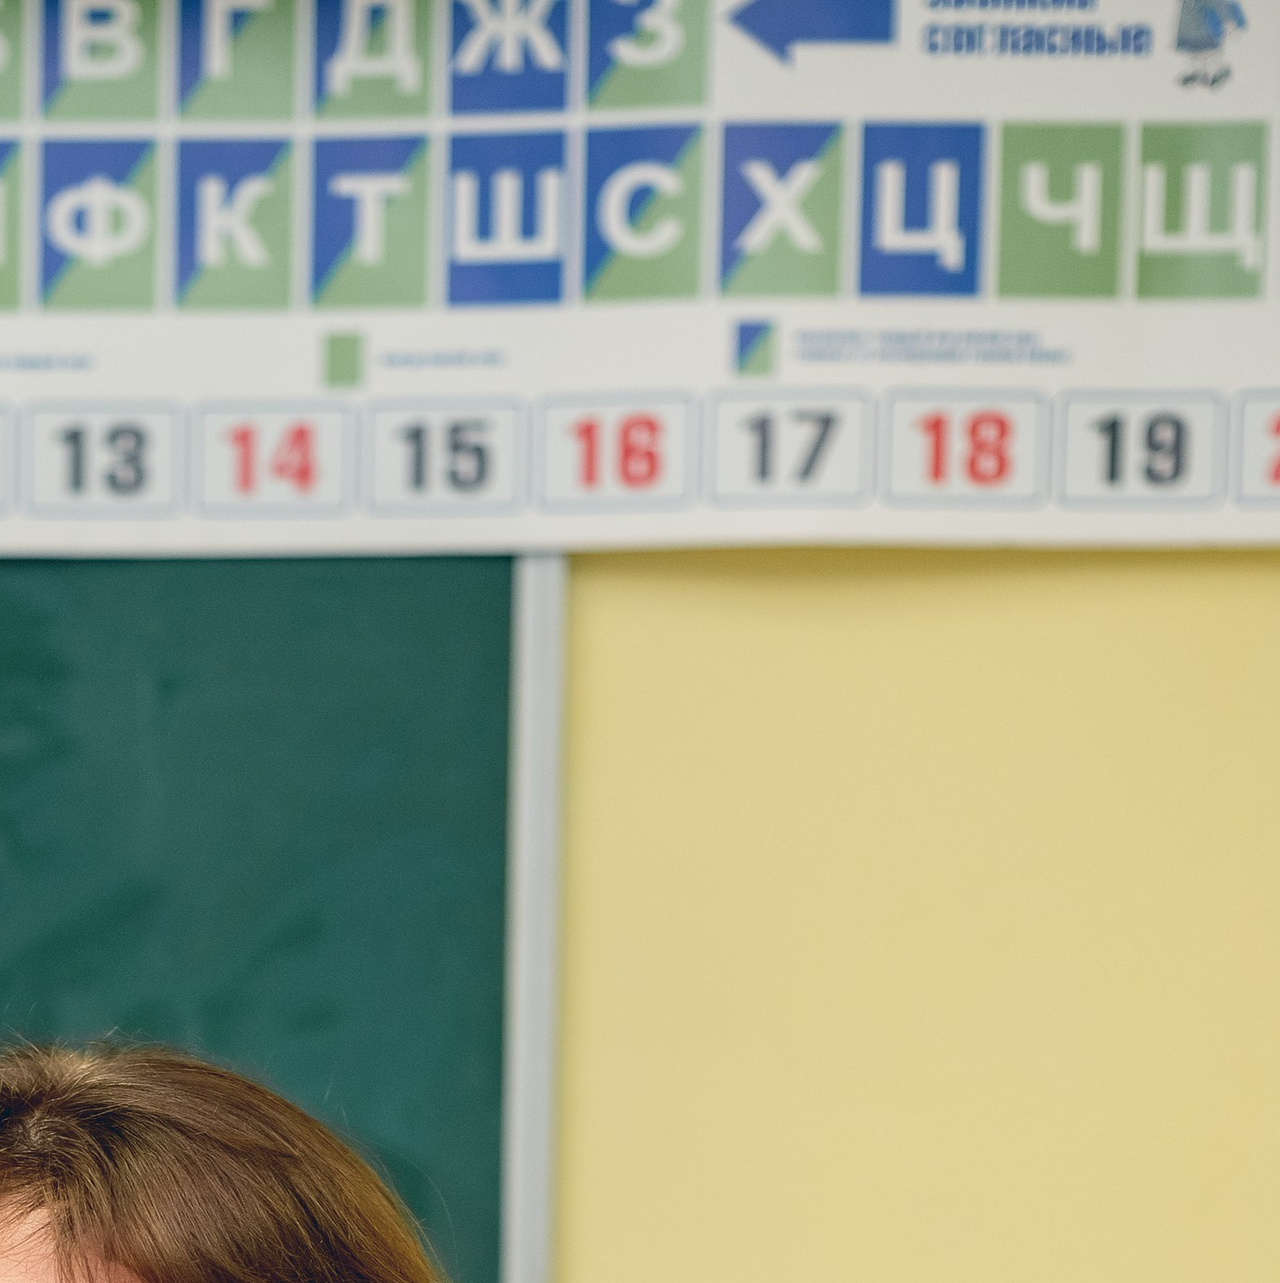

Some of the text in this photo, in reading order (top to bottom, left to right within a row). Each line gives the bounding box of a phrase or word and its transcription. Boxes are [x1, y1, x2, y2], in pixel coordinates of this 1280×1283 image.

[47, 176, 149, 267] Ф
[196, 176, 273, 268] К
[330, 174, 412, 265] Т
[453, 170, 562, 264] Ш
[598, 161, 684, 256] С
[736, 161, 821, 254] Х
[875, 160, 964, 272] Ц
[1024, 163, 1101, 254] Ч
[1143, 162, 1261, 271] Щ
[59, 424, 147, 496] 13
[230, 422, 316, 494] 14
[401, 418, 490, 492] 15
[573, 414, 665, 488] 16
[744, 410, 838, 486] 17
[918, 410, 1014, 486] 18
[1091, 411, 1189, 486] 19
